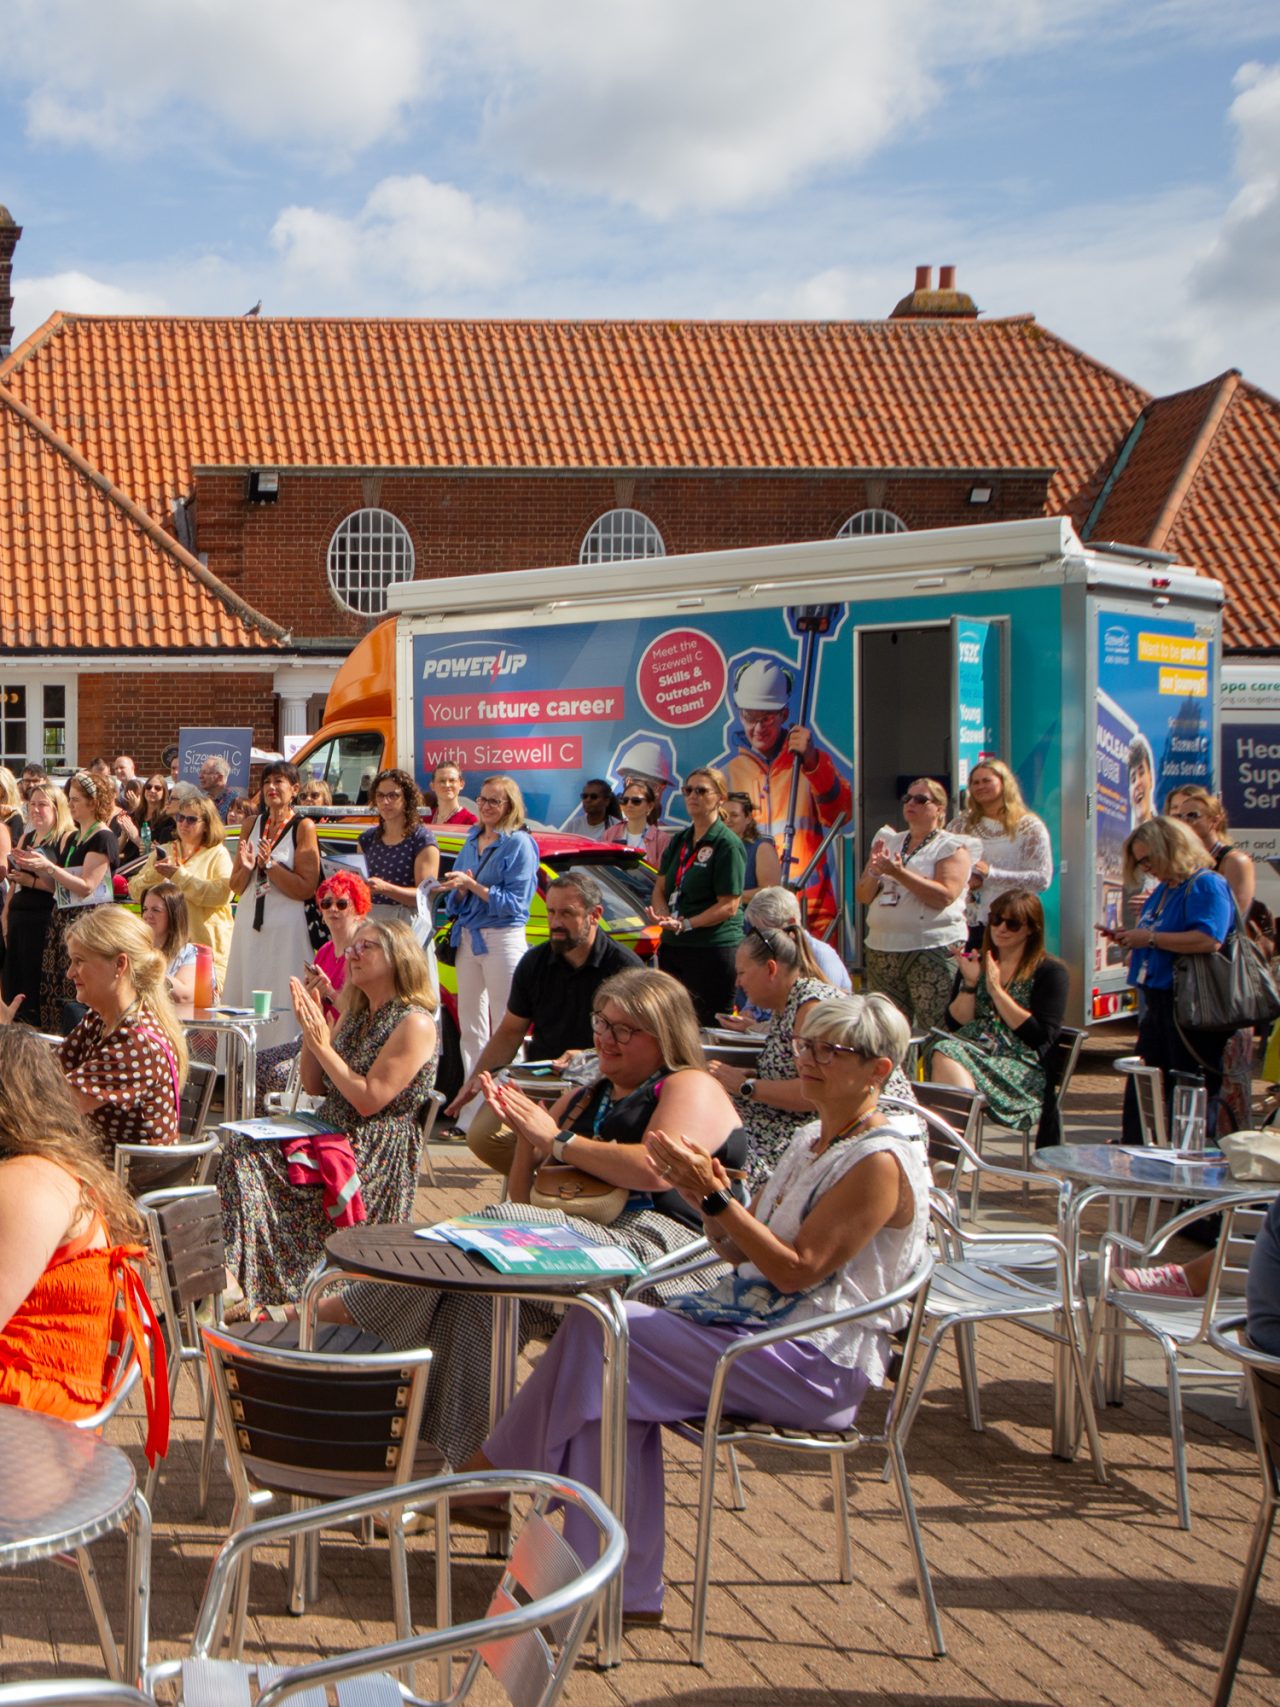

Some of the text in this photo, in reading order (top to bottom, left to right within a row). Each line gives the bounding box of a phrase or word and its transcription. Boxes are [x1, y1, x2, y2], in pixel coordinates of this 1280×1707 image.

[652, 640, 697, 659] Meet the
[652, 651, 703, 674] Sizewell C
[659, 667, 702, 687] Skills &
[656, 680, 711, 703] Outreach
[429, 699, 614, 720] Your future career
[667, 697, 705, 716] Team!
[1172, 736, 1208, 752] Sizewell C
[184, 750, 242, 766] Sizell C
[428, 743, 574, 765] with Sizewell C
[1161, 761, 1207, 776] Jobs Service
[1253, 839, 1276, 849] and
